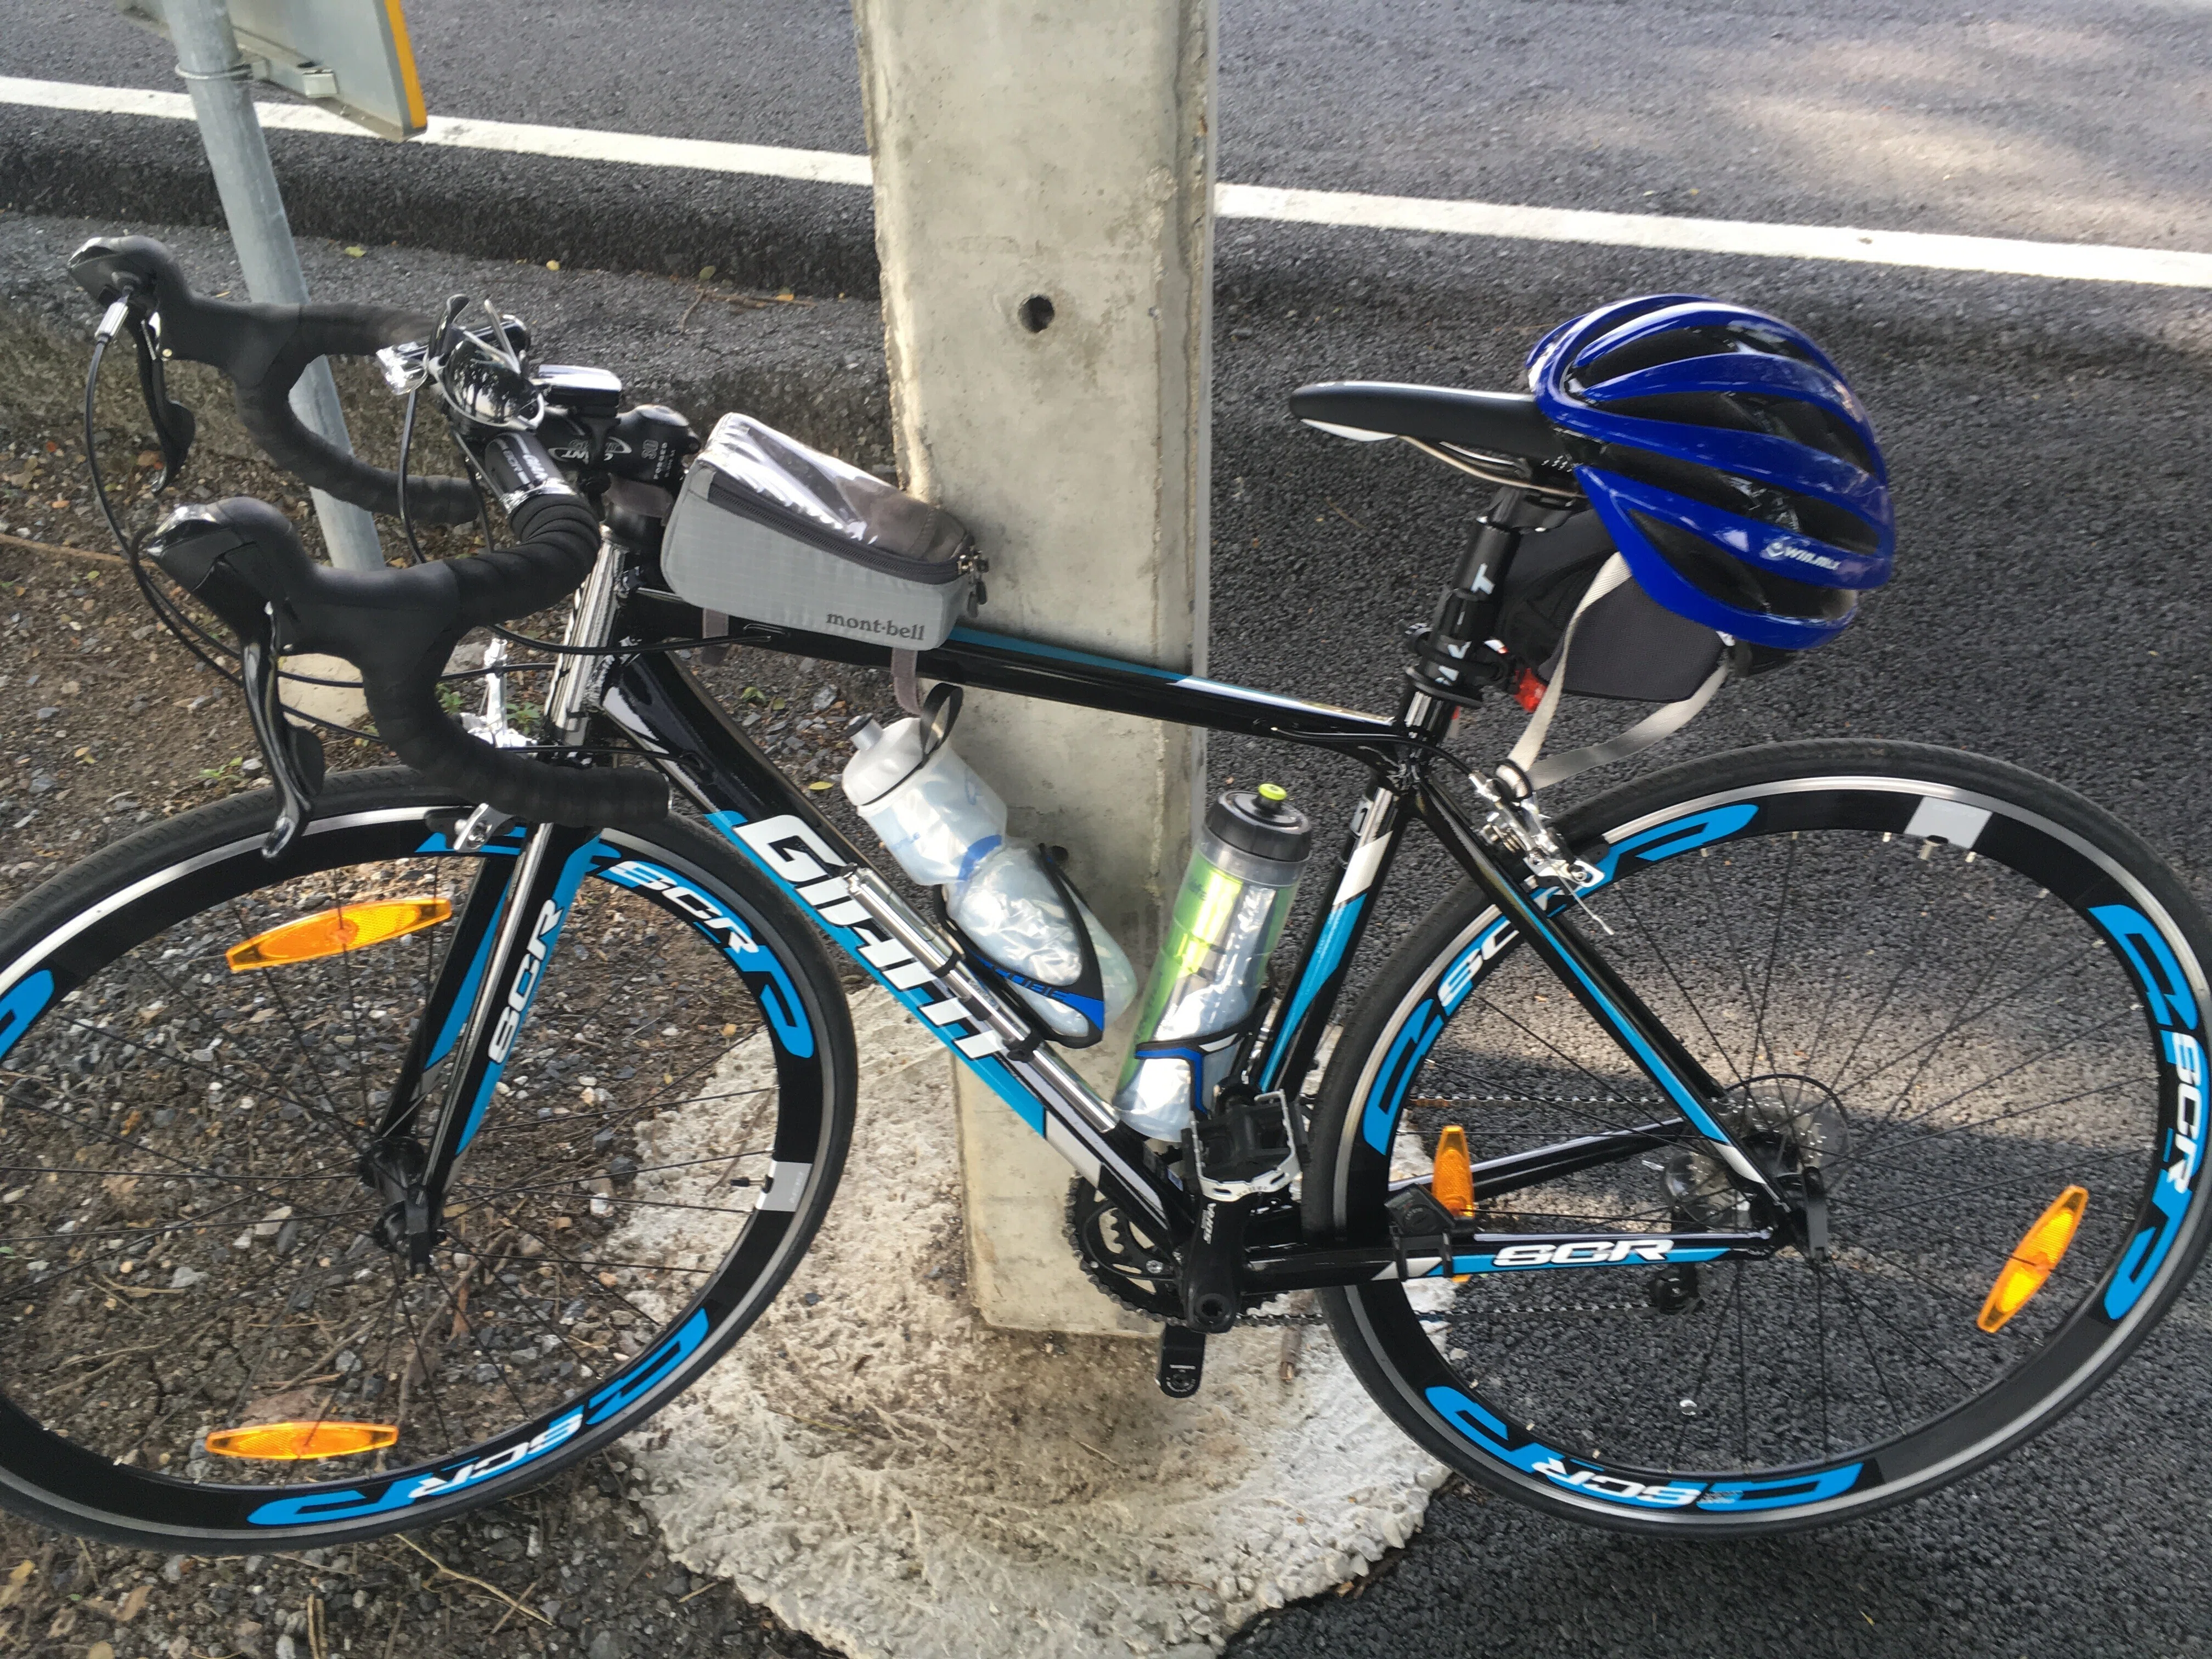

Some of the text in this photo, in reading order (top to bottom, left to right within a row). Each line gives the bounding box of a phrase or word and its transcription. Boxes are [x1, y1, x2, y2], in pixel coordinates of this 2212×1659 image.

[608, 860, 759, 953] SCR
[488, 899, 563, 1064] SCR
[2167, 1031, 2203, 1194] SCR
[1493, 1239, 1674, 1266] SCR
[408, 1413, 583, 1498] SCR
[1531, 1457, 1701, 1505] SCR
